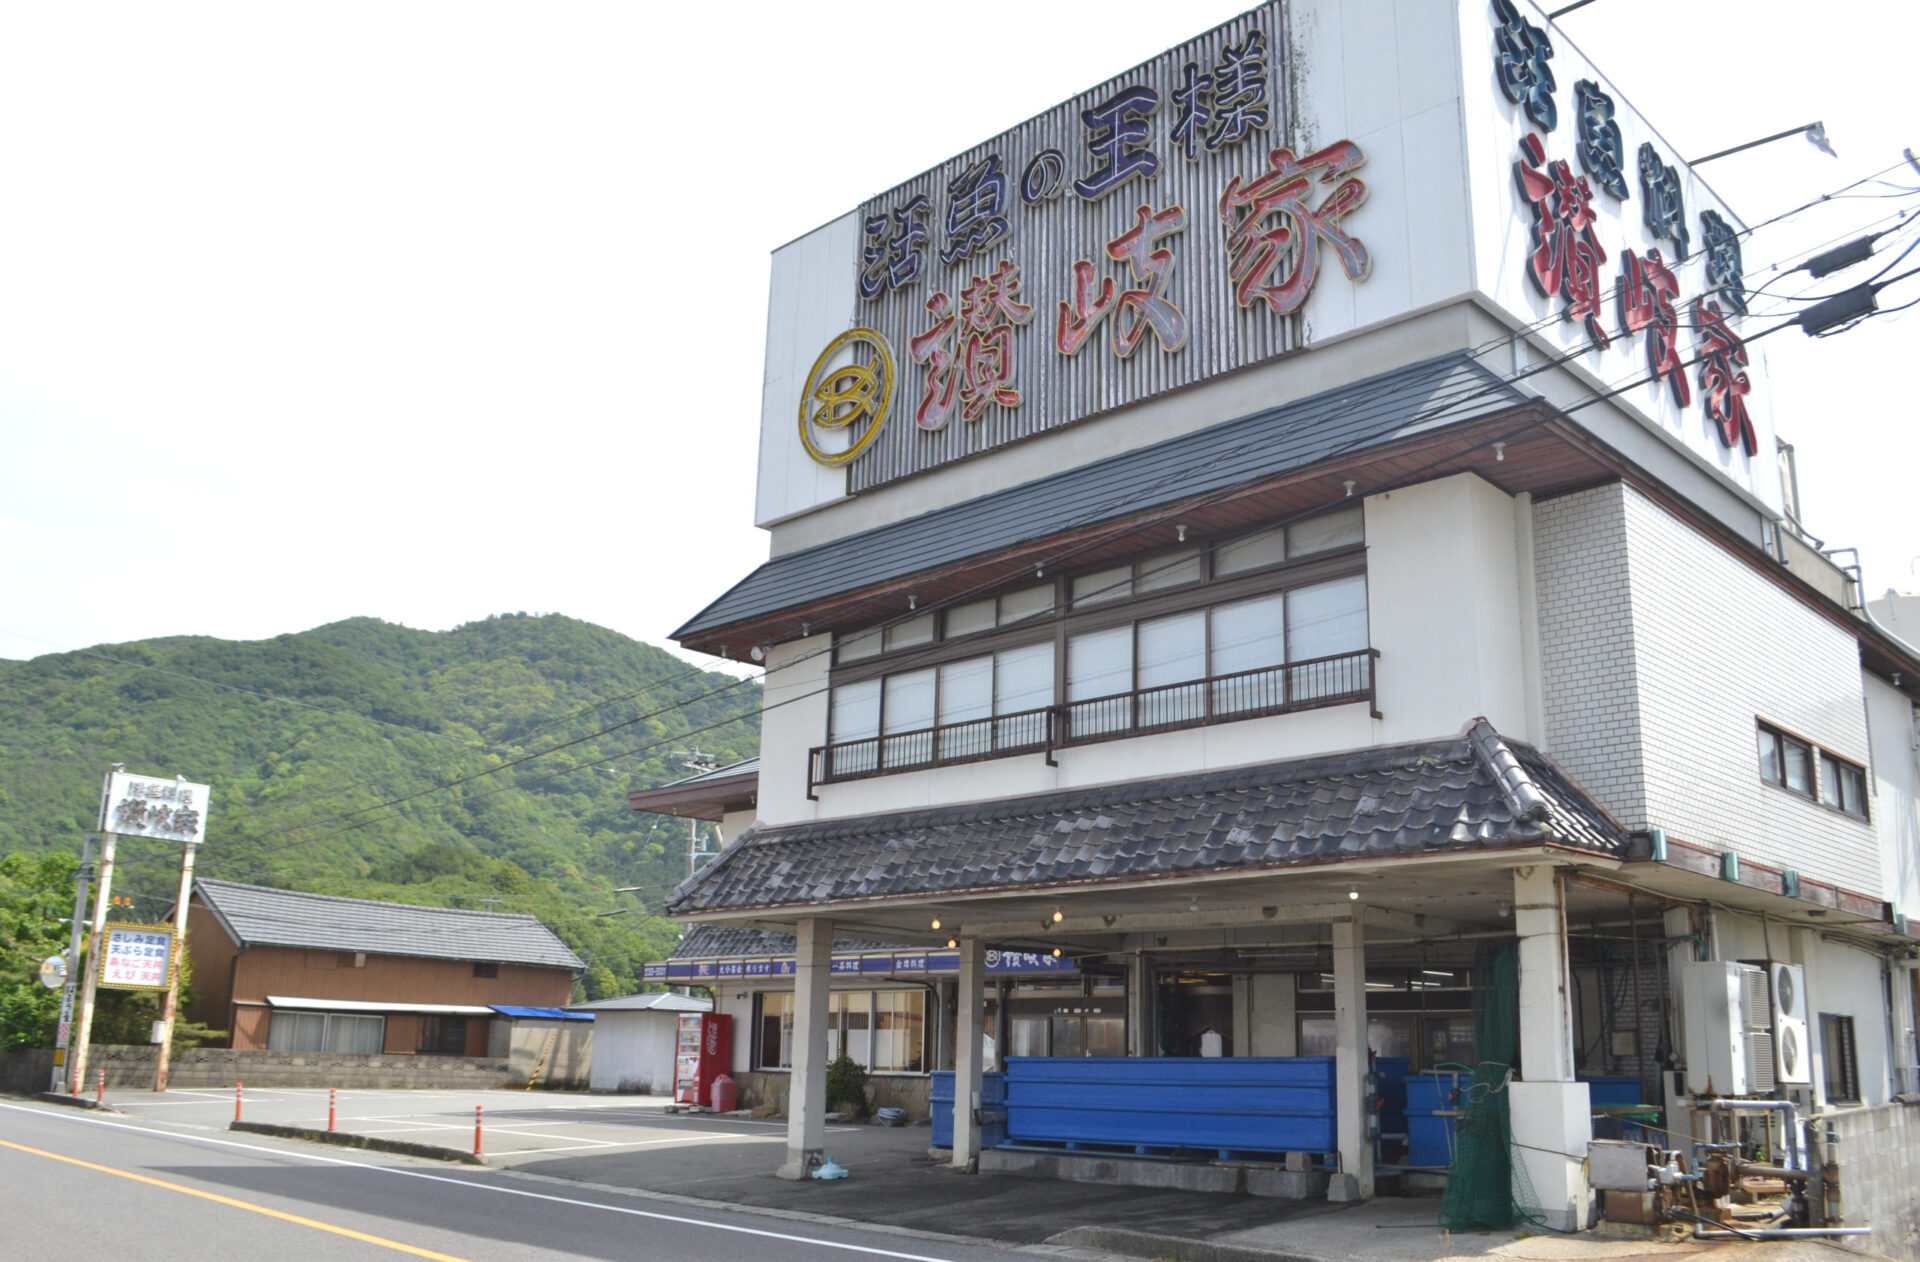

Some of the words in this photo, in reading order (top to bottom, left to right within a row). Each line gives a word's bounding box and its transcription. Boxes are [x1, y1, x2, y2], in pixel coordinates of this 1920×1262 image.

[860, 28, 1271, 301] 活魚の王様
[910, 138, 1373, 433] 讃岐家
[1492, 0, 1748, 315] 活魚料理
[1514, 132, 1758, 457] 讃岐家
[113, 933, 165, 945] さしみ定食
[116, 798, 200, 836] 讃岐家
[110, 957, 163, 969] あなご天丼
